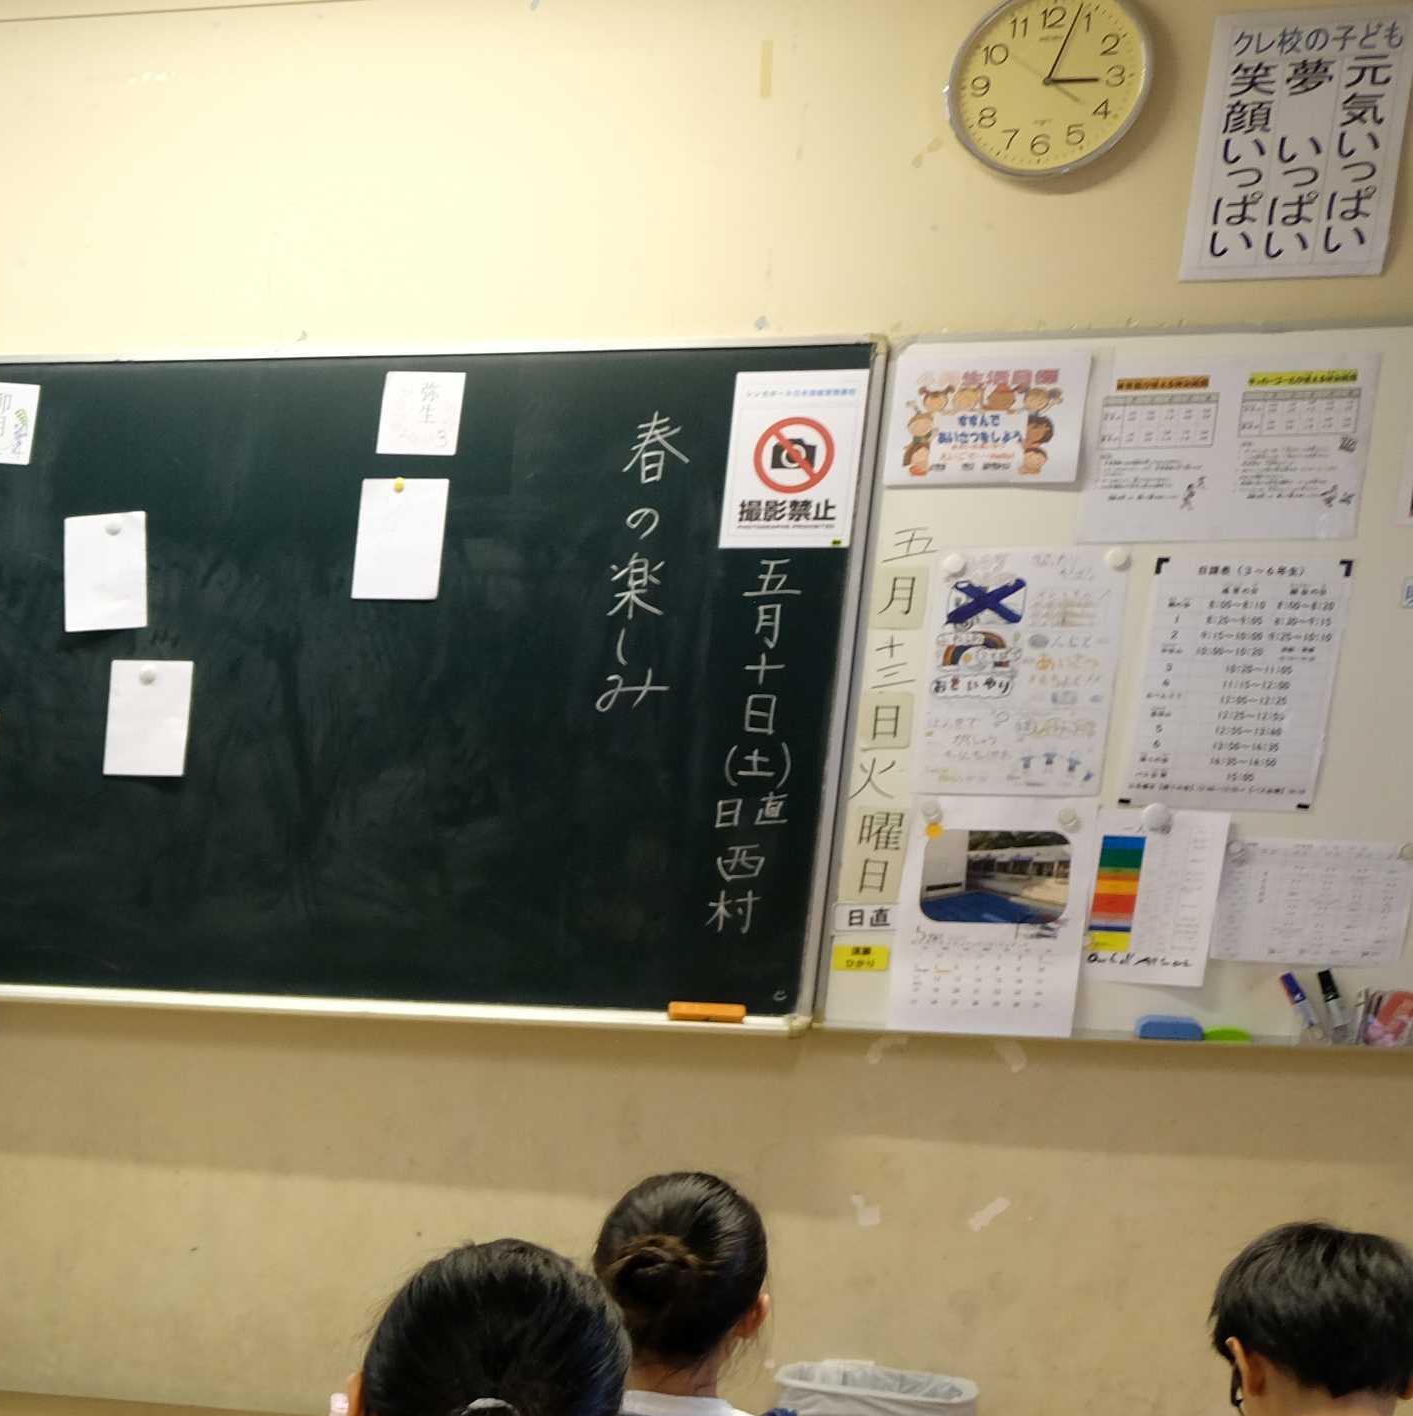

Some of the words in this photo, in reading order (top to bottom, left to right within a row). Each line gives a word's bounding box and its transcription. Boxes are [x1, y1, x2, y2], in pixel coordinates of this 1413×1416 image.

[1009, 17, 1028, 38] 11
[1041, 6, 1066, 29] 12
[1084, 12, 1092, 33] 1
[1100, 33, 1120, 56] 2
[1234, 22, 1404, 56] クレ校の子ども
[982, 43, 1009, 65] 10
[971, 75, 990, 97] 9
[1105, 64, 1125, 87] 3
[978, 106, 997, 128] 8
[1092, 98, 1111, 120] 4
[1001, 128, 1020, 150] 7
[1030, 133, 1051, 156] 6
[1066, 123, 1085, 145] 5
[1210, 62, 1278, 257] 笑顔いっぱい
[1266, 58, 1336, 258] 夢いっぱい
[1324, 54, 1393, 253] 元気いっぱい
[739, 499, 836, 522] 撮影禁止
[595, 411, 690, 713] 春の楽しみ
[848, 907, 890, 927] 日直
